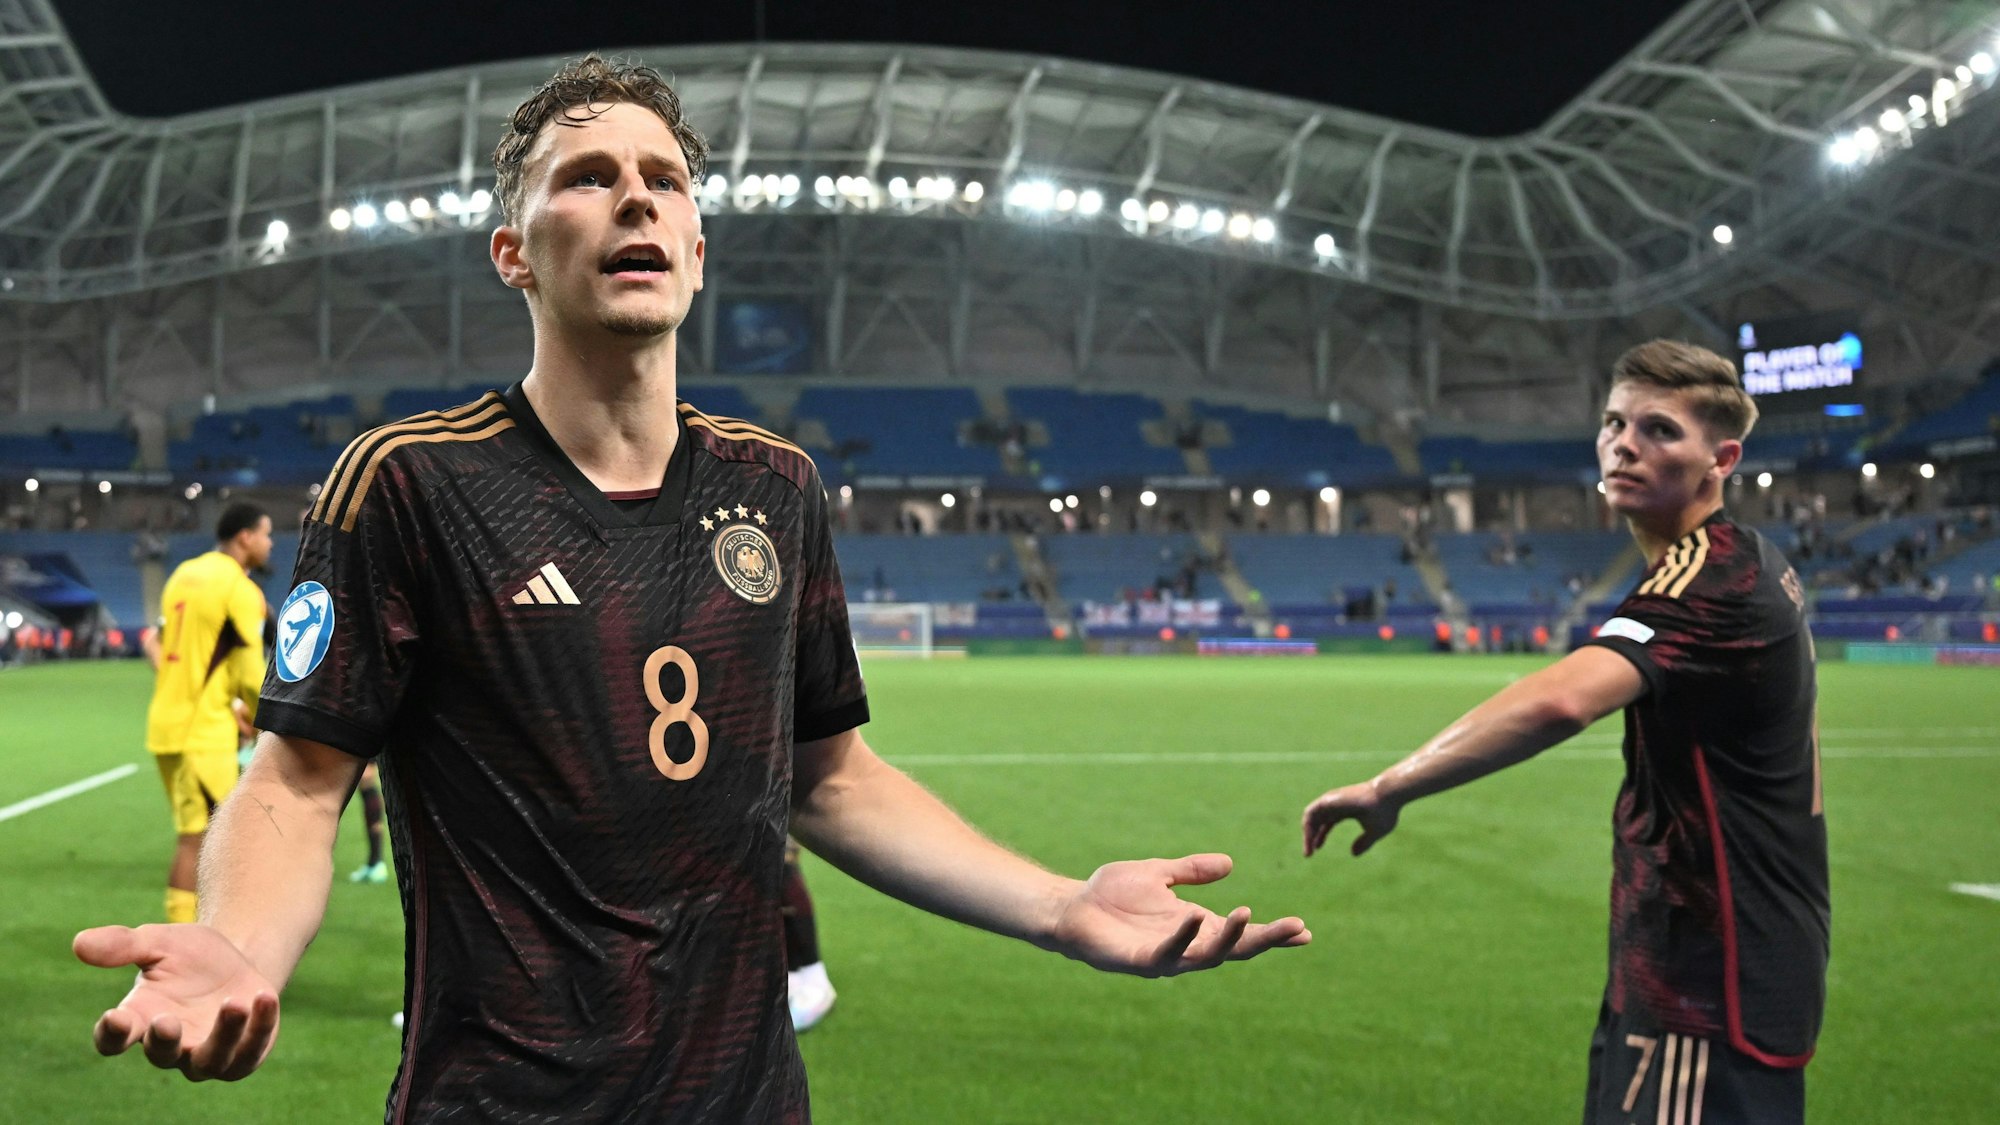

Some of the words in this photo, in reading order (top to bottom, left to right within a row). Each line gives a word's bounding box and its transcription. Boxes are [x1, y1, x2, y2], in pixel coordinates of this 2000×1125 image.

[1744, 345, 1817, 373] PLAYER
[1743, 372, 1782, 395] THE
[1782, 366, 1853, 391] MATCH
[726, 534, 763, 551] DEUTSCHER
[642, 645, 710, 781] 8
[1622, 1033, 1658, 1112] 7
